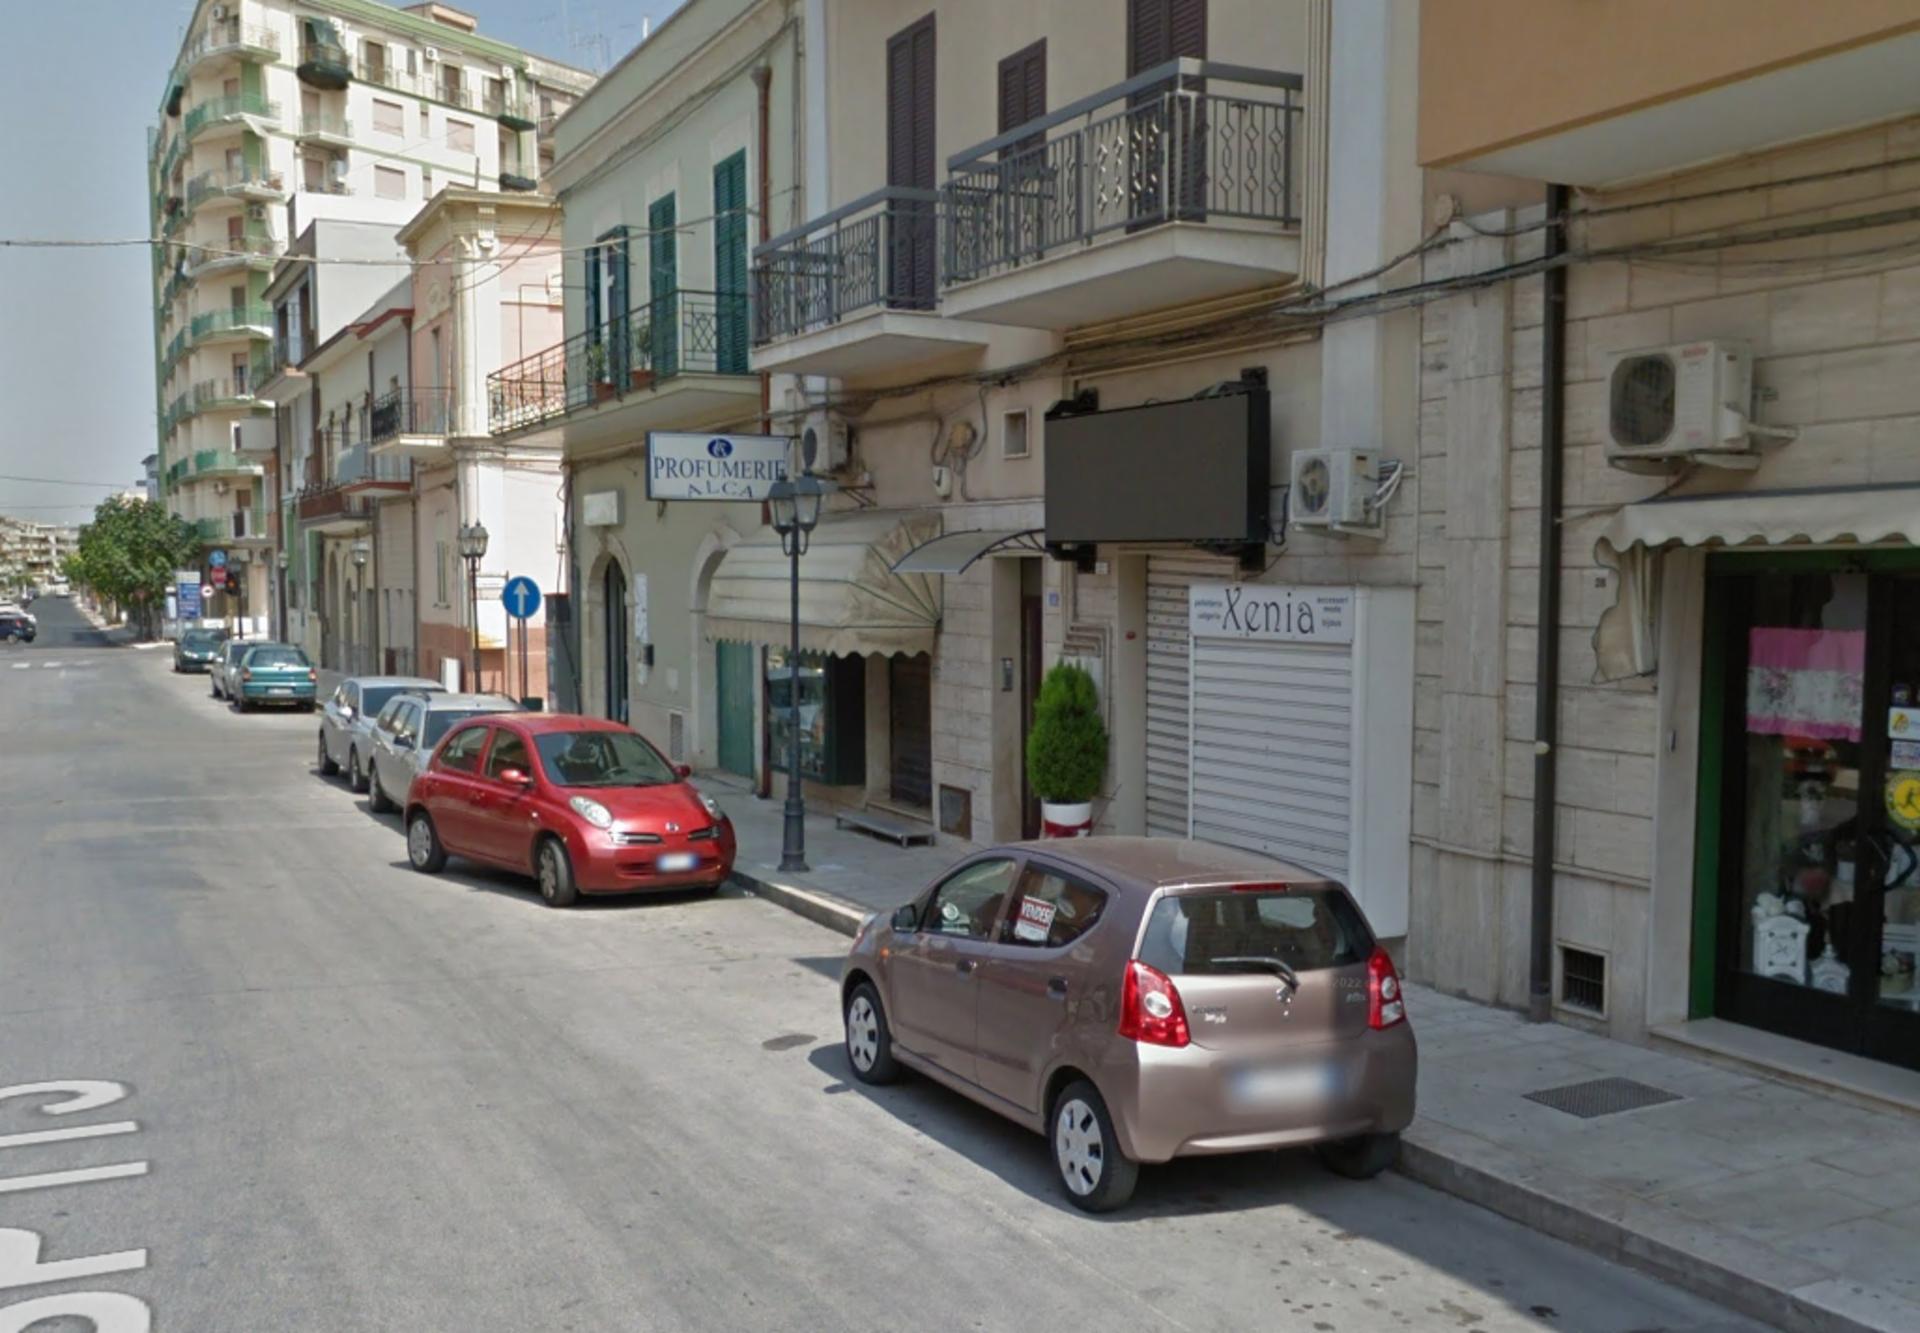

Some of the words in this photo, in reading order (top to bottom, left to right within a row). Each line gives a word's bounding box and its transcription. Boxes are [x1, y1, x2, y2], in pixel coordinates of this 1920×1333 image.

[654, 456, 785, 480] PROFUMERIE
[688, 480, 753, 498] ALCA
[1222, 586, 1315, 636] Xenia
